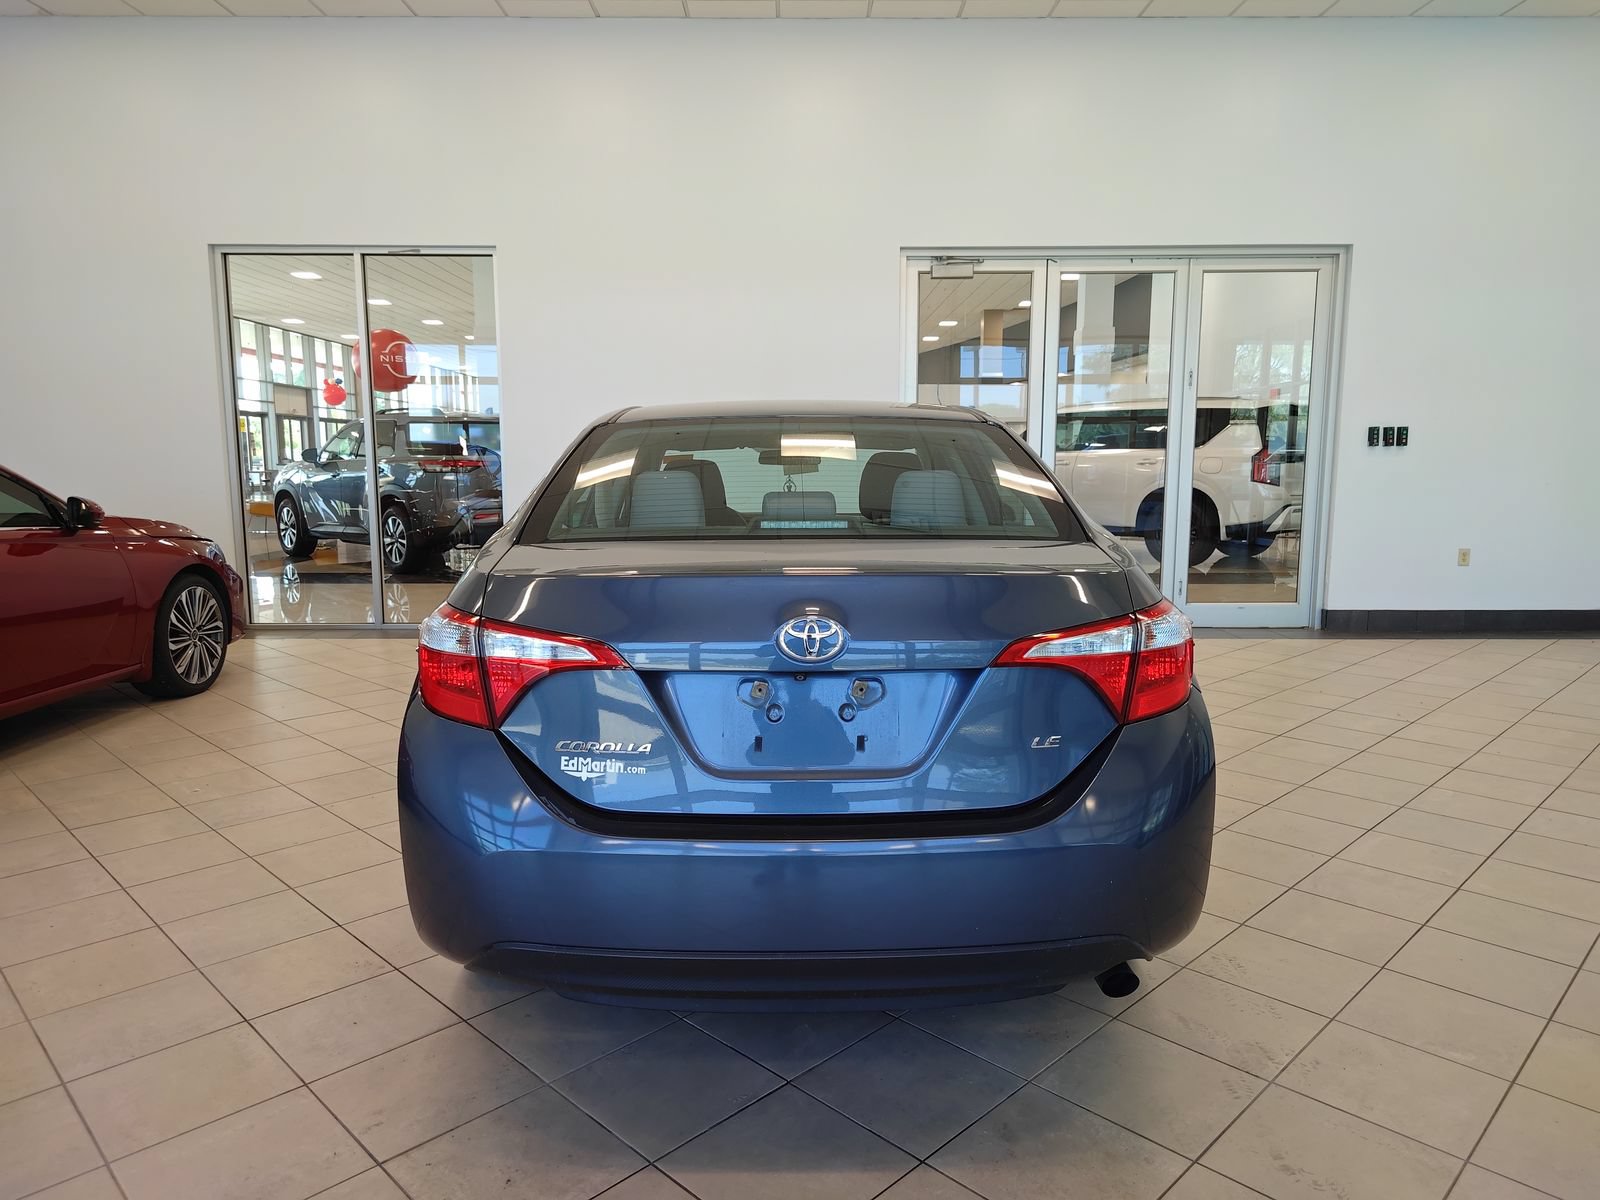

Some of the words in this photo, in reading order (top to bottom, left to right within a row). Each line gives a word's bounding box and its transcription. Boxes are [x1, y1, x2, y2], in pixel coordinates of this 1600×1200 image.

[380, 354, 404, 363] NIS
[555, 740, 652, 755] COROLLA
[1031, 736, 1062, 749] LE
[560, 756, 646, 776] EdMartin.com
